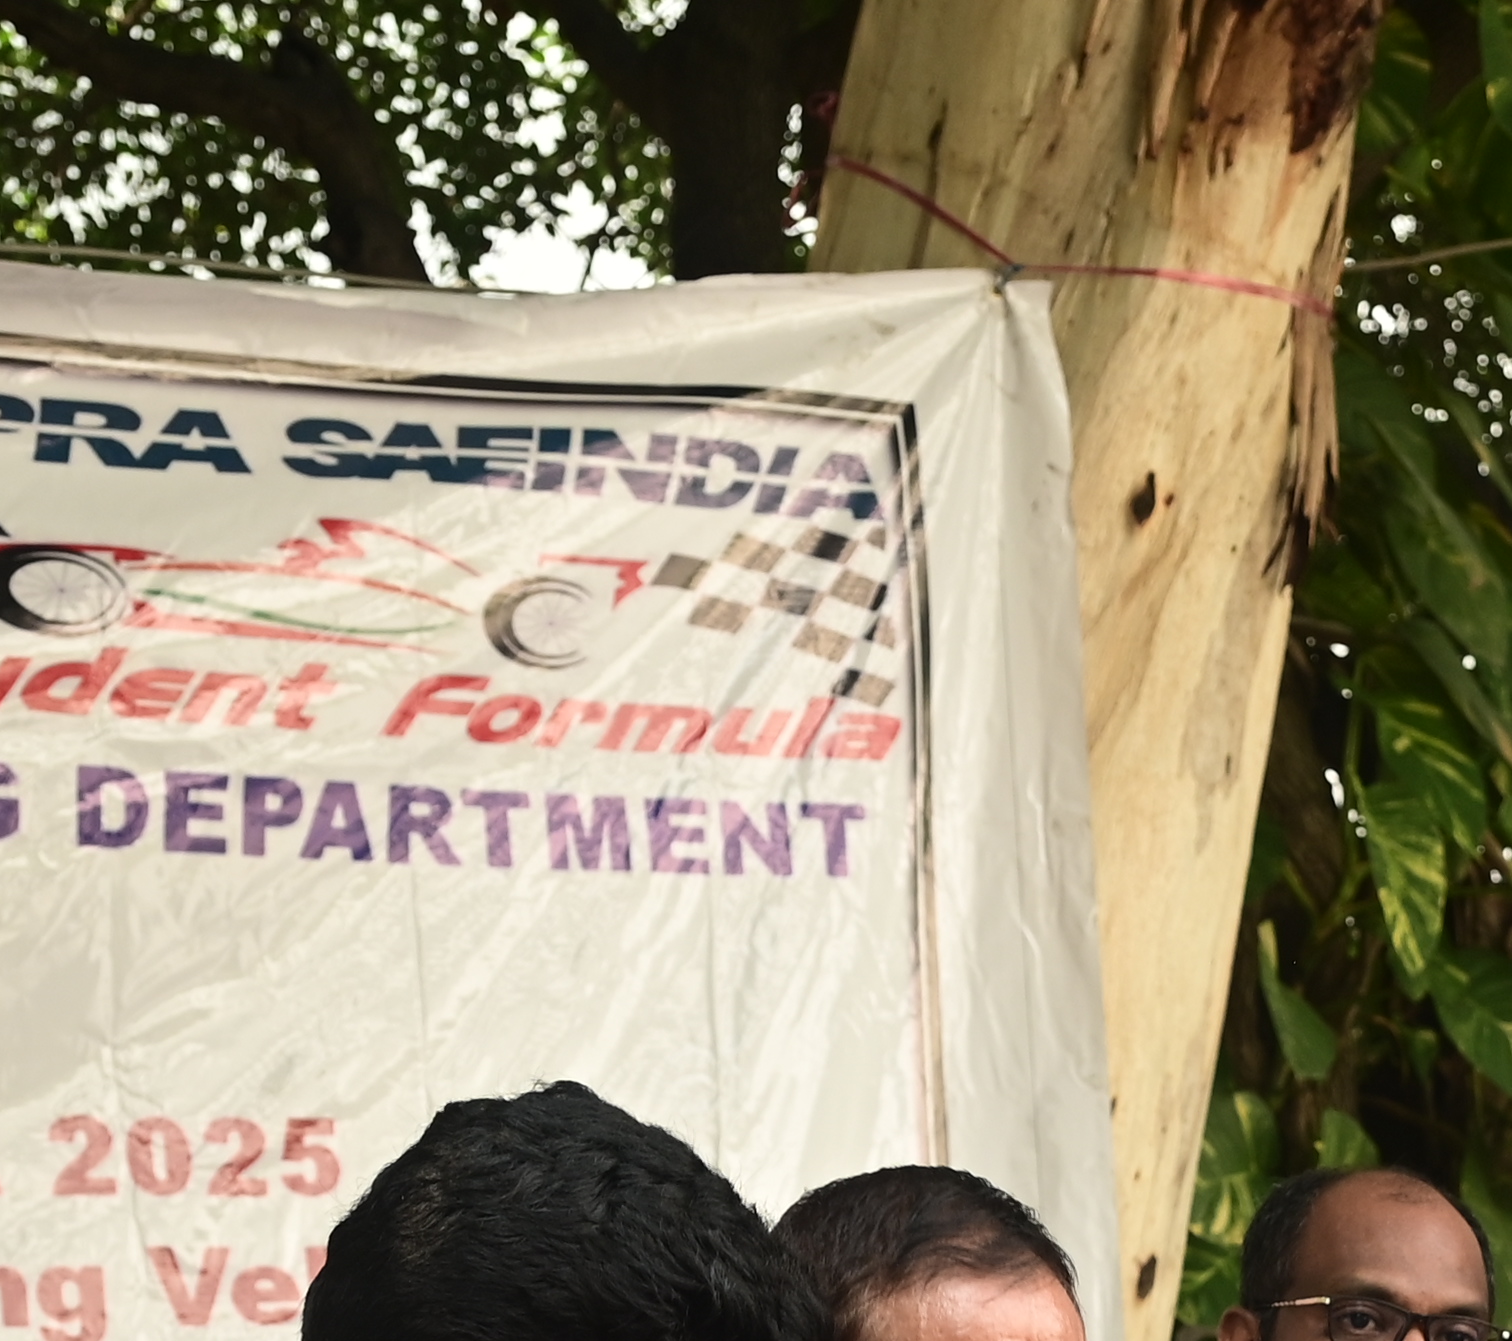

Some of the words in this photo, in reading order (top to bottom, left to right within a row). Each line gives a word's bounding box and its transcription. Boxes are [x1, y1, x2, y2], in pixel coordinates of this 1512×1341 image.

[282, 418, 886, 522] SAEINDIA
[380, 673, 902, 762] Formula
[79, 766, 866, 878] DEPARTMENT
[48, 1113, 342, 1197] 2025
